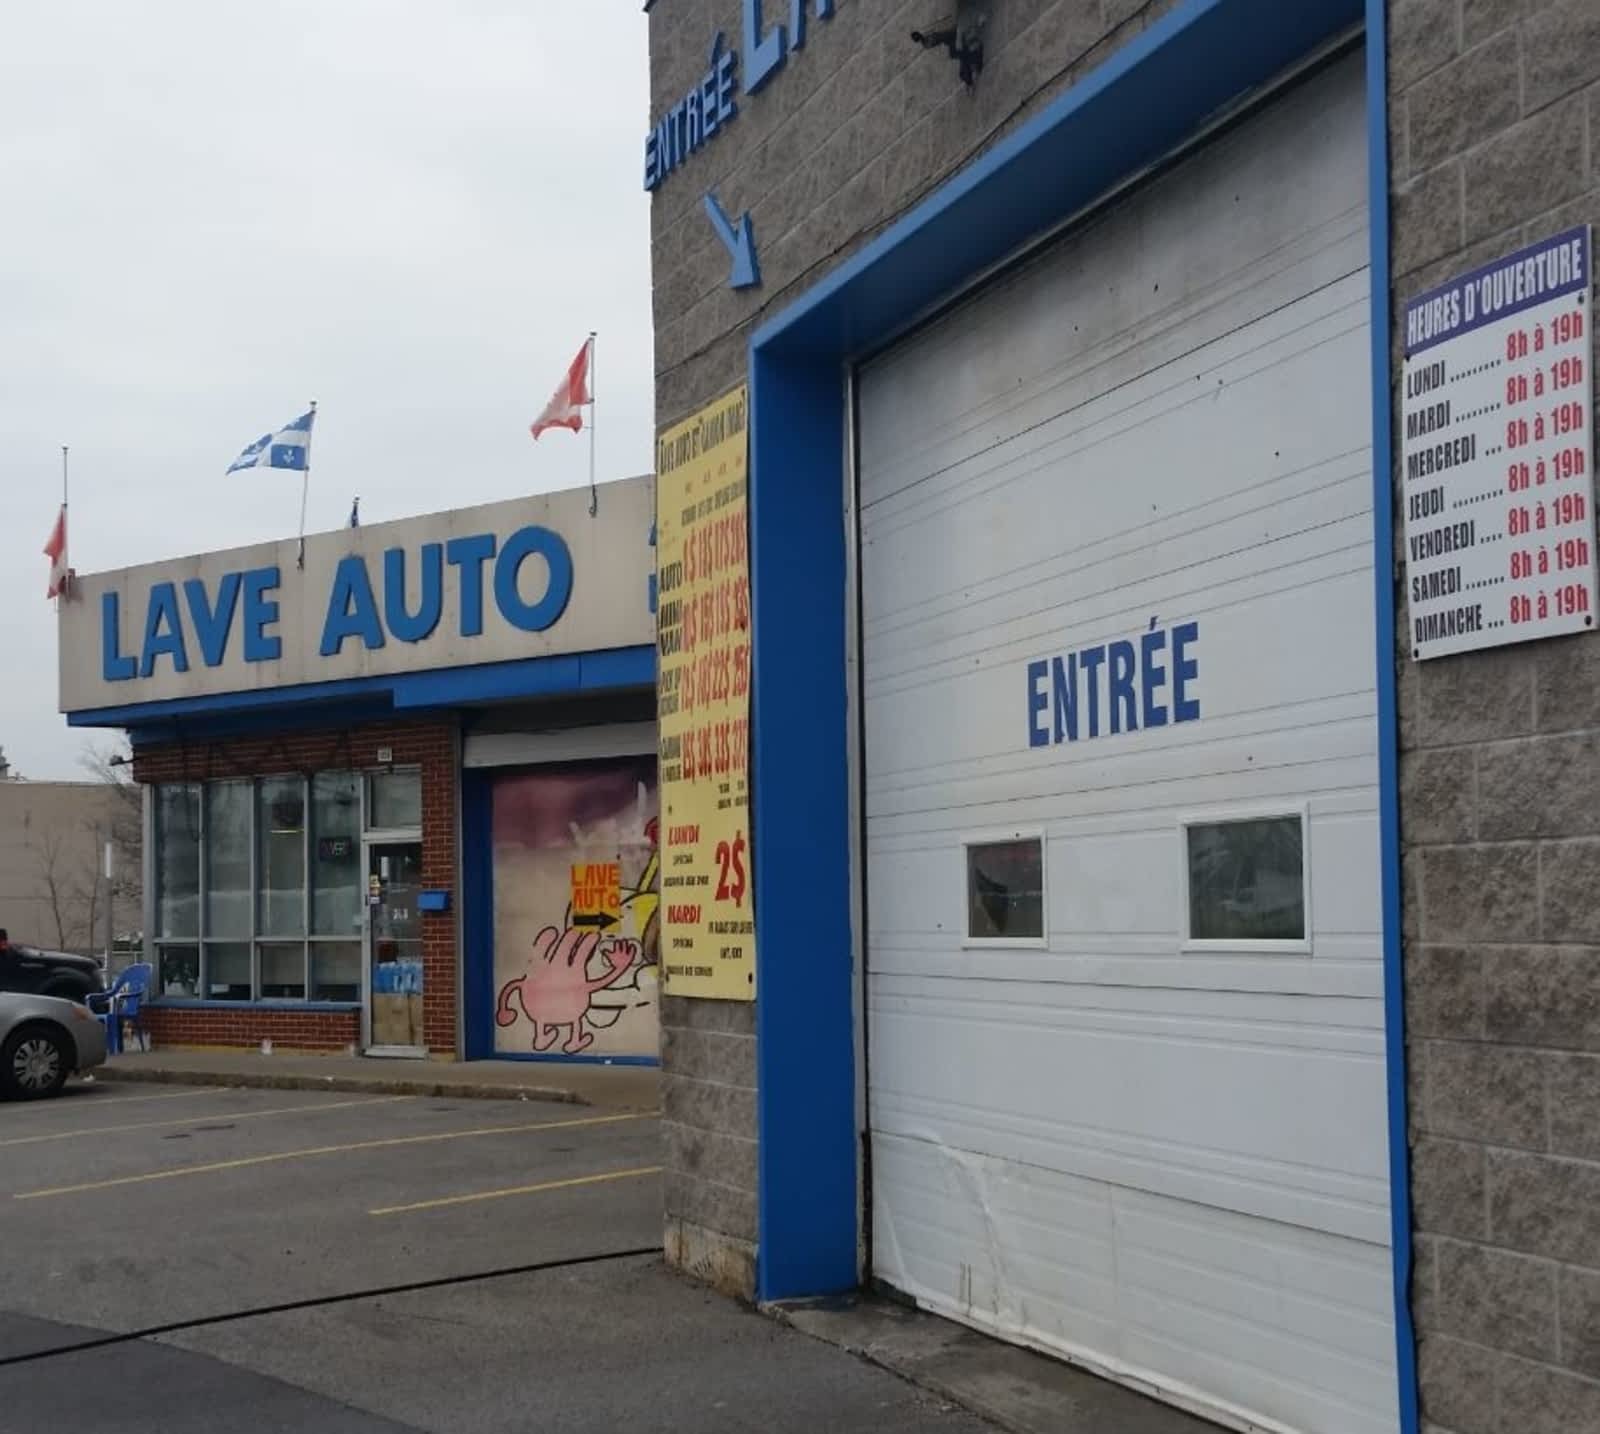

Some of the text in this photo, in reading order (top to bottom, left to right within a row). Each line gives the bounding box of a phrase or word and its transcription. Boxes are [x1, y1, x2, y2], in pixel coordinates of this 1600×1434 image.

[644, 29, 739, 191] ENTRÉE
[1407, 238, 1582, 347] HEURES D'OUVERTURE
[1506, 330, 1528, 361] 8h
[1534, 323, 1545, 352] à
[1551, 311, 1583, 345] 19h
[1506, 374, 1528, 405] 8h
[1534, 367, 1544, 397] à
[1551, 356, 1583, 390] 19h
[1507, 419, 1528, 449] 8h
[1534, 412, 1545, 441] à
[1551, 401, 1583, 436] 19h
[1508, 463, 1530, 492] 8h
[1536, 457, 1546, 485] à
[1552, 448, 1585, 480] 19h
[1508, 506, 1530, 536] 8h
[1536, 501, 1546, 530] à
[1552, 493, 1585, 526] 19h
[1510, 550, 1532, 580] 8h
[1538, 546, 1548, 574] à
[1555, 538, 1588, 571] 19h
[102, 566, 283, 682] LAVE
[319, 525, 574, 657] AUTO
[1510, 594, 1532, 624] 8h
[1538, 590, 1548, 619] à
[1554, 584, 1588, 617] 19h
[1027, 616, 1200, 749] ENTRÉE
[668, 825, 699, 846] LUNDI
[571, 863, 619, 886] LAVE
[714, 830, 746, 907] 2$
[574, 887, 619, 909] AUTO
